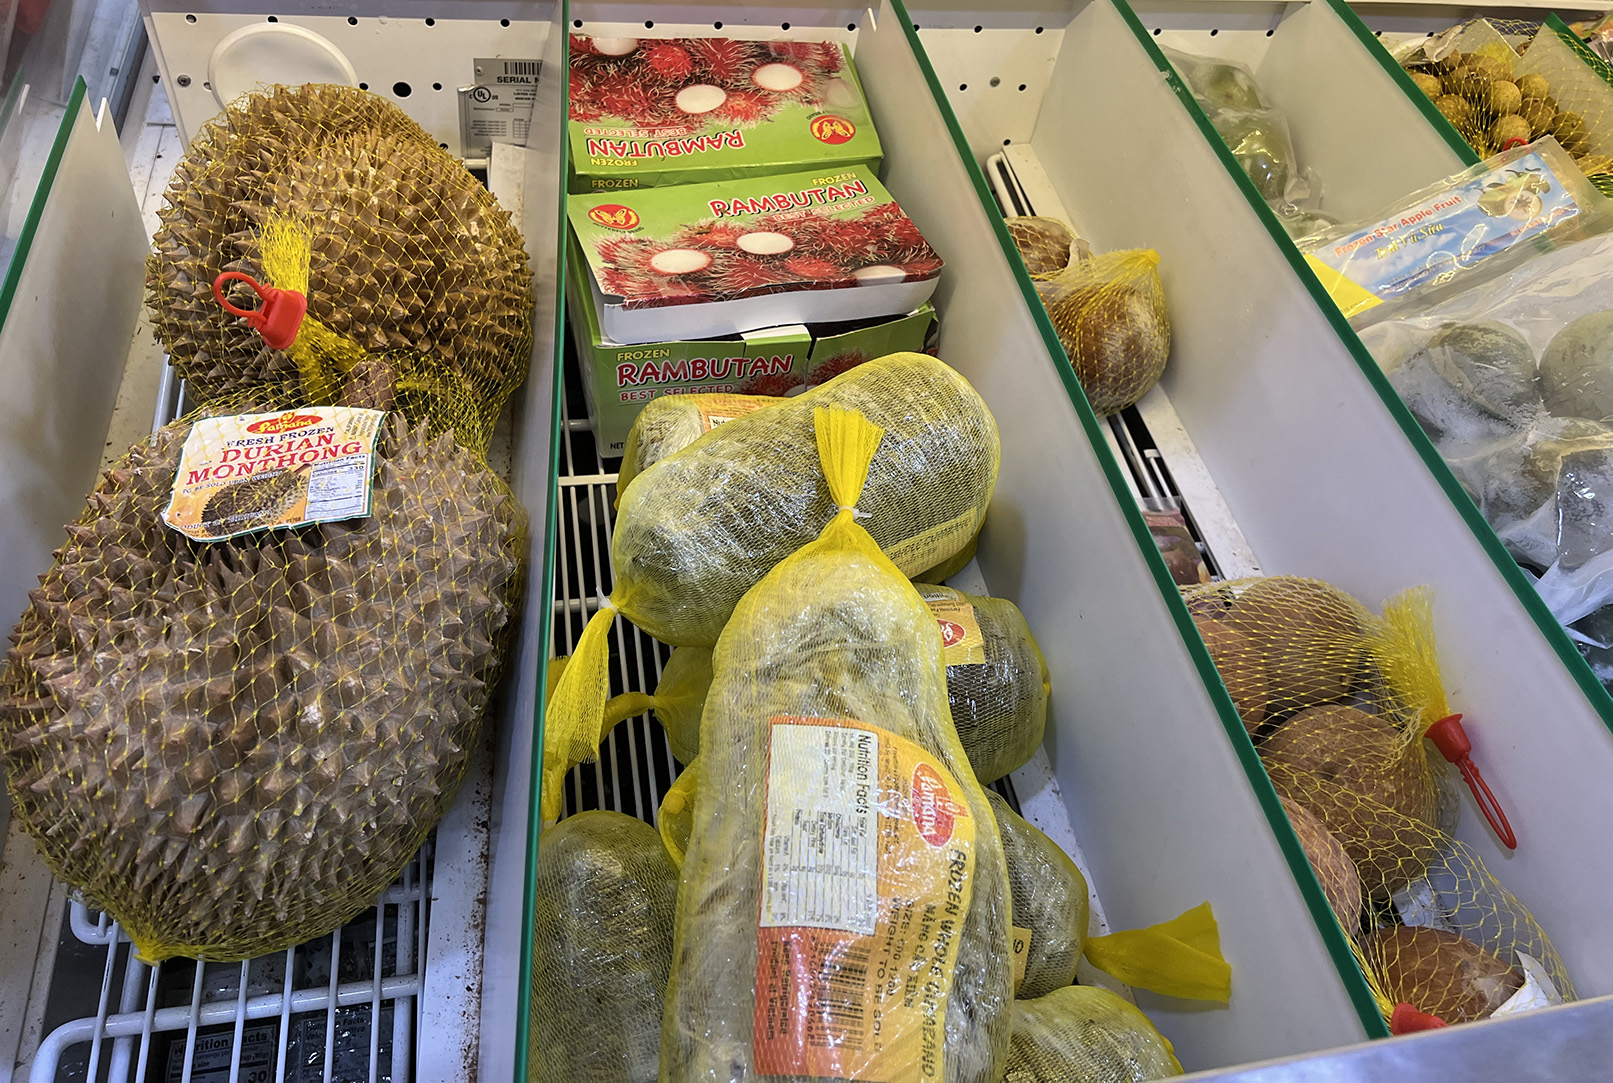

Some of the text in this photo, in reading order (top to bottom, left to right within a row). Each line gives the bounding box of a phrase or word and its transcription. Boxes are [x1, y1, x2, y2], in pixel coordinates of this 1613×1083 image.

[496, 76, 532, 84] SERIAL
[477, 89, 487, 100] UL
[583, 127, 687, 138] BEST SELECTED
[587, 129, 747, 159] RAMBUTAN
[590, 158, 639, 168] FROZEN
[591, 178, 639, 189] FROZEN
[812, 172, 857, 187] FROZEN
[709, 179, 869, 220] RAMBUTAN
[1333, 195, 1463, 258] Frozen Star Apple Fruit
[616, 348, 671, 361] FROZEN
[616, 354, 794, 388] RAMBUTAN
[620, 383, 735, 402] BEST SELECTED
[219, 432, 336, 464] DURIAN
[226, 435, 275, 448] FRESH
[279, 425, 336, 442] FROZEN
[610, 442, 624, 451] NET
[185, 440, 363, 487] MONTHONG
[855, 733, 872, 815] Nutrition Facts
[917, 772, 943, 836] Pamana
[945, 848, 968, 917] FROZEN
[881, 896, 902, 954] WEIGHT
[928, 919, 956, 979] WHOLE
[875, 958, 888, 979] TO
[766, 996, 780, 1041] Vietnam
[173, 1031, 268, 1056] Nrition acts
[247, 1070, 267, 1083] 30
